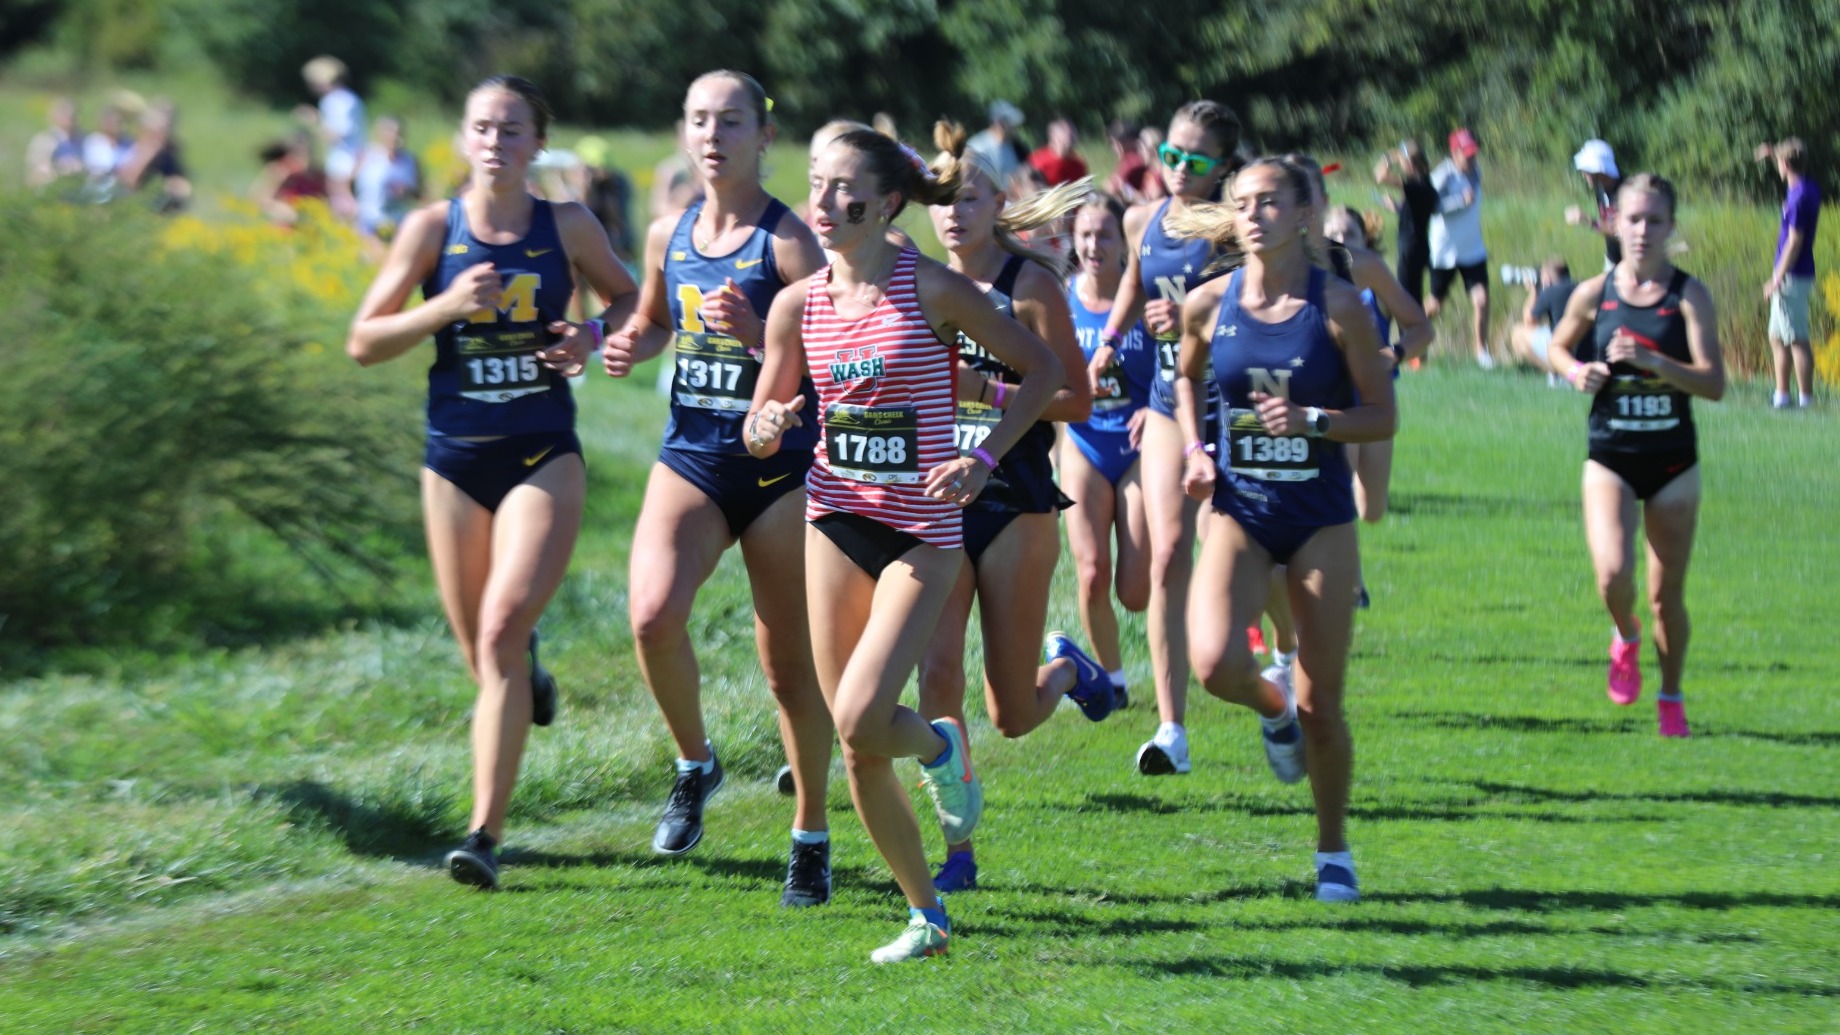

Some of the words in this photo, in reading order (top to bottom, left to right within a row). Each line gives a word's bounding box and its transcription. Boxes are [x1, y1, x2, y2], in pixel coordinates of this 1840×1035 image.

[1154, 274, 1187, 305] N
[466, 355, 540, 385] 1315
[677, 357, 742, 391] 1317
[829, 355, 886, 384] WASH
[1243, 367, 1293, 412] N
[834, 433, 907, 464] 1788
[1237, 436, 1309, 463] 1389
